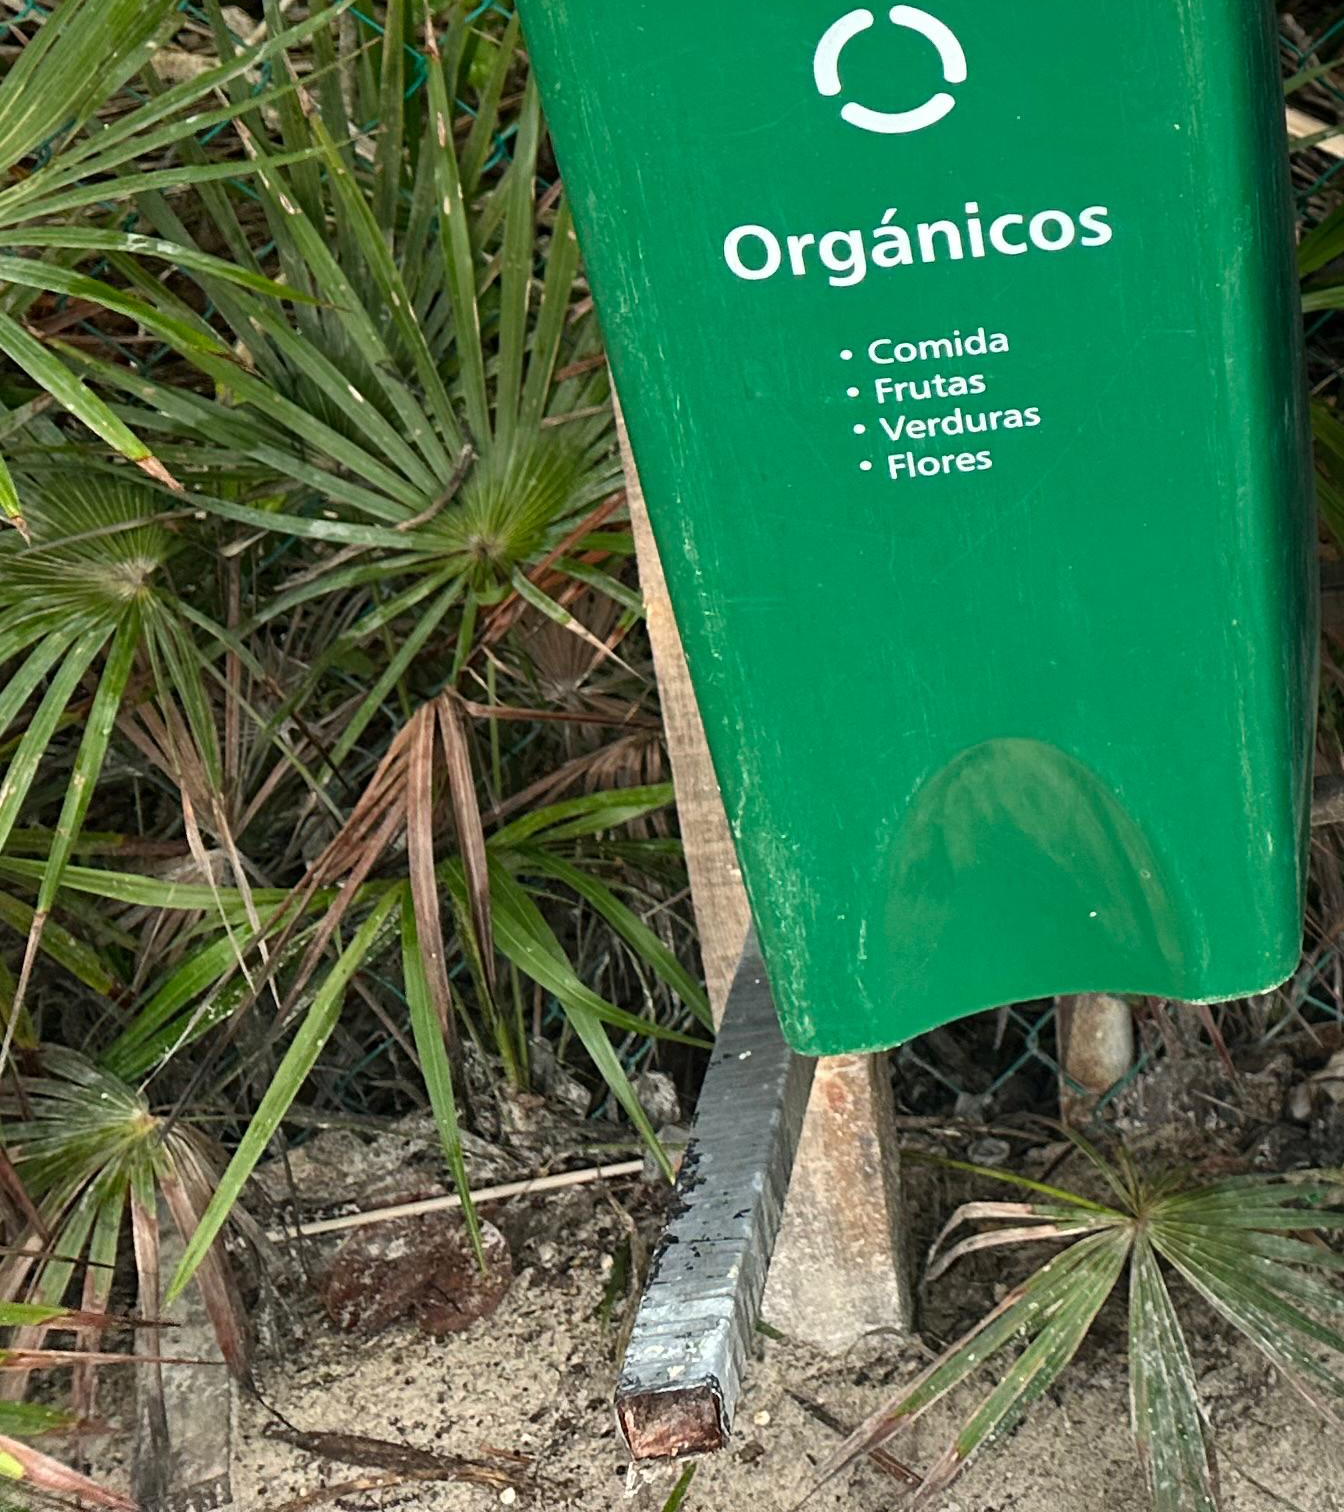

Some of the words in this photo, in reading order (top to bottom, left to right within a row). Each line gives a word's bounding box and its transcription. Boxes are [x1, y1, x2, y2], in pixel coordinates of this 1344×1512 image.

[723, 201, 1113, 287] Orgánicos
[867, 327, 1010, 365] Comida
[874, 372, 987, 405] Frutas
[879, 406, 1042, 441] Verduras
[887, 449, 993, 480] Flores
